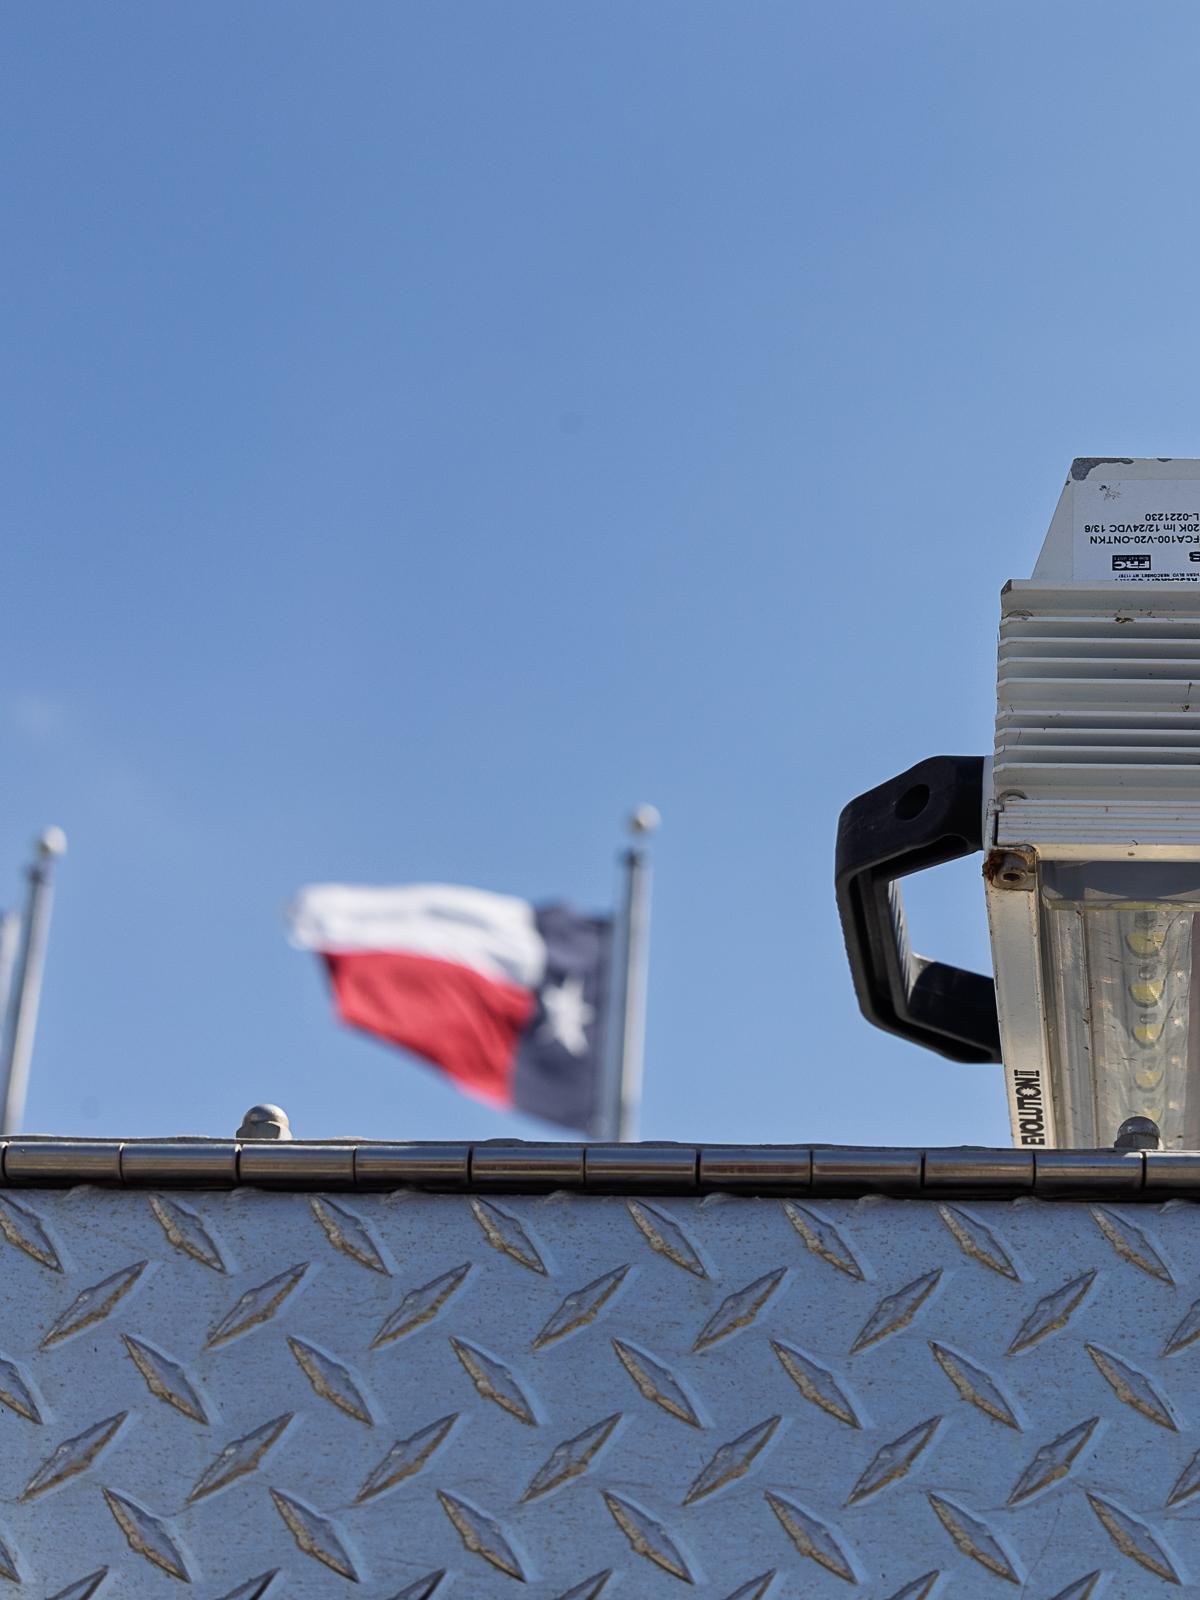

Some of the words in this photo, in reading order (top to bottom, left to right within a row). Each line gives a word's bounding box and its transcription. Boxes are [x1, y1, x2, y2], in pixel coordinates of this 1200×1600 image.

[1145, 513, 1200, 523] L-0221230
[1109, 524, 1160, 534] 12/24VDC
[1179, 523, 1200, 533] 20K
[1113, 561, 1150, 570] FRC
